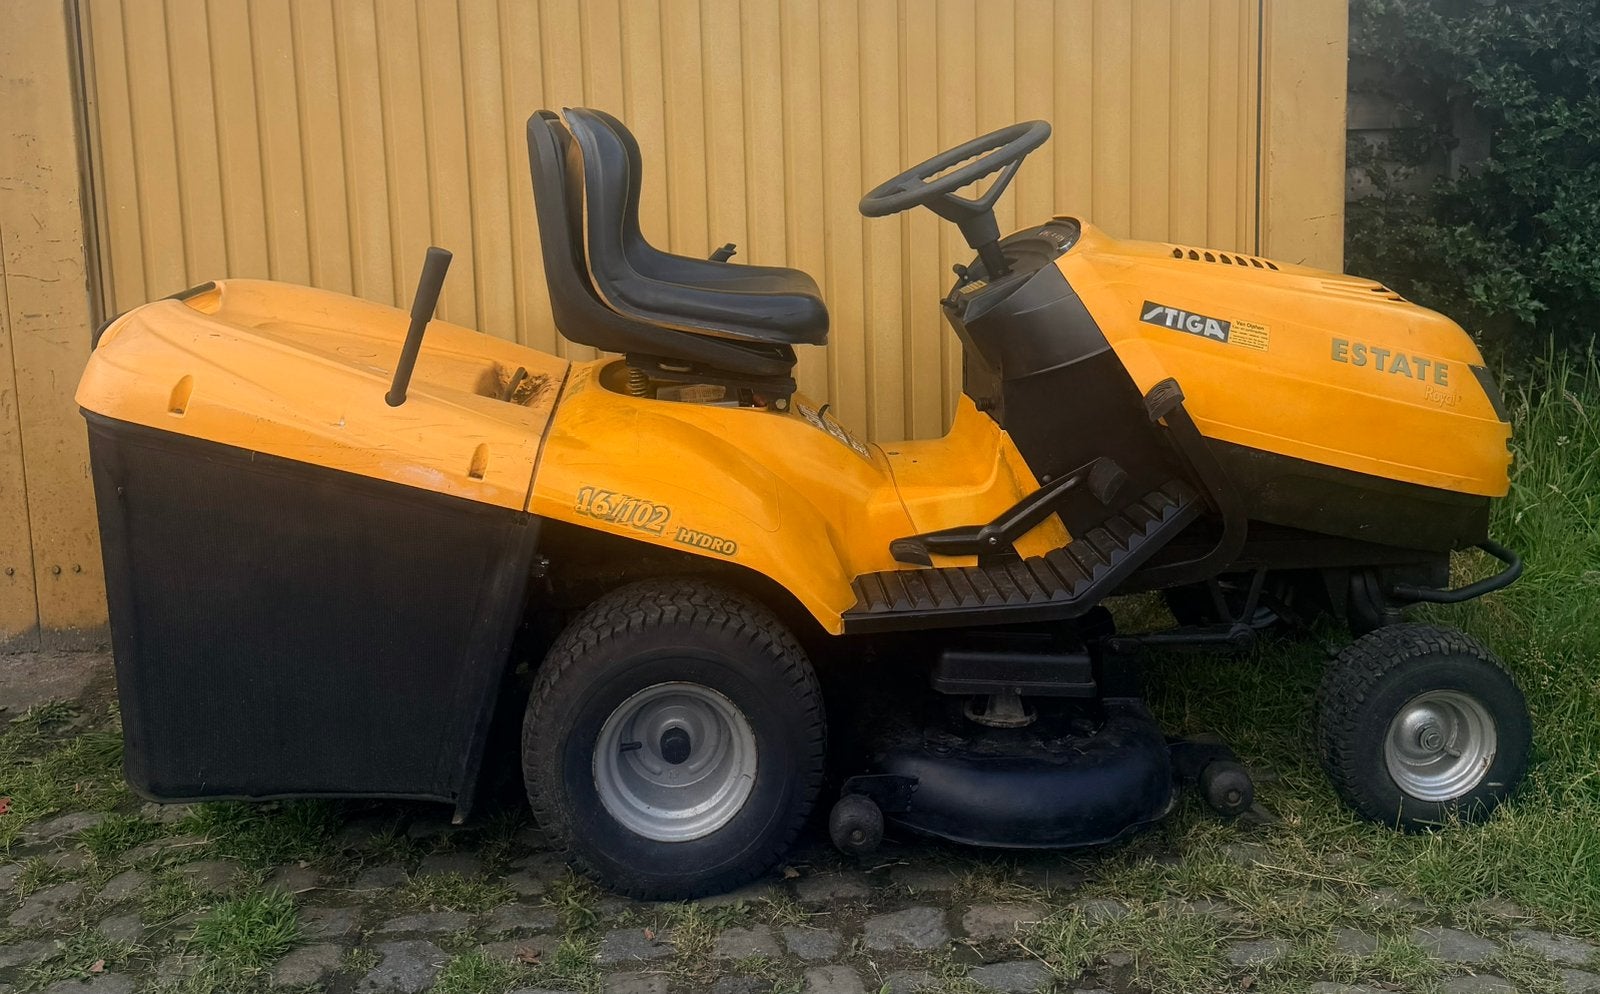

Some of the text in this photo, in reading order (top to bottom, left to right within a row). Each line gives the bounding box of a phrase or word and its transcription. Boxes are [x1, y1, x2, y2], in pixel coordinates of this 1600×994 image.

[1143, 306, 1225, 340] STIGA
[1331, 337, 1449, 387] ESTATE
[1424, 385, 1457, 408] Royal
[575, 487, 737, 556] 16/102 HYDRO
